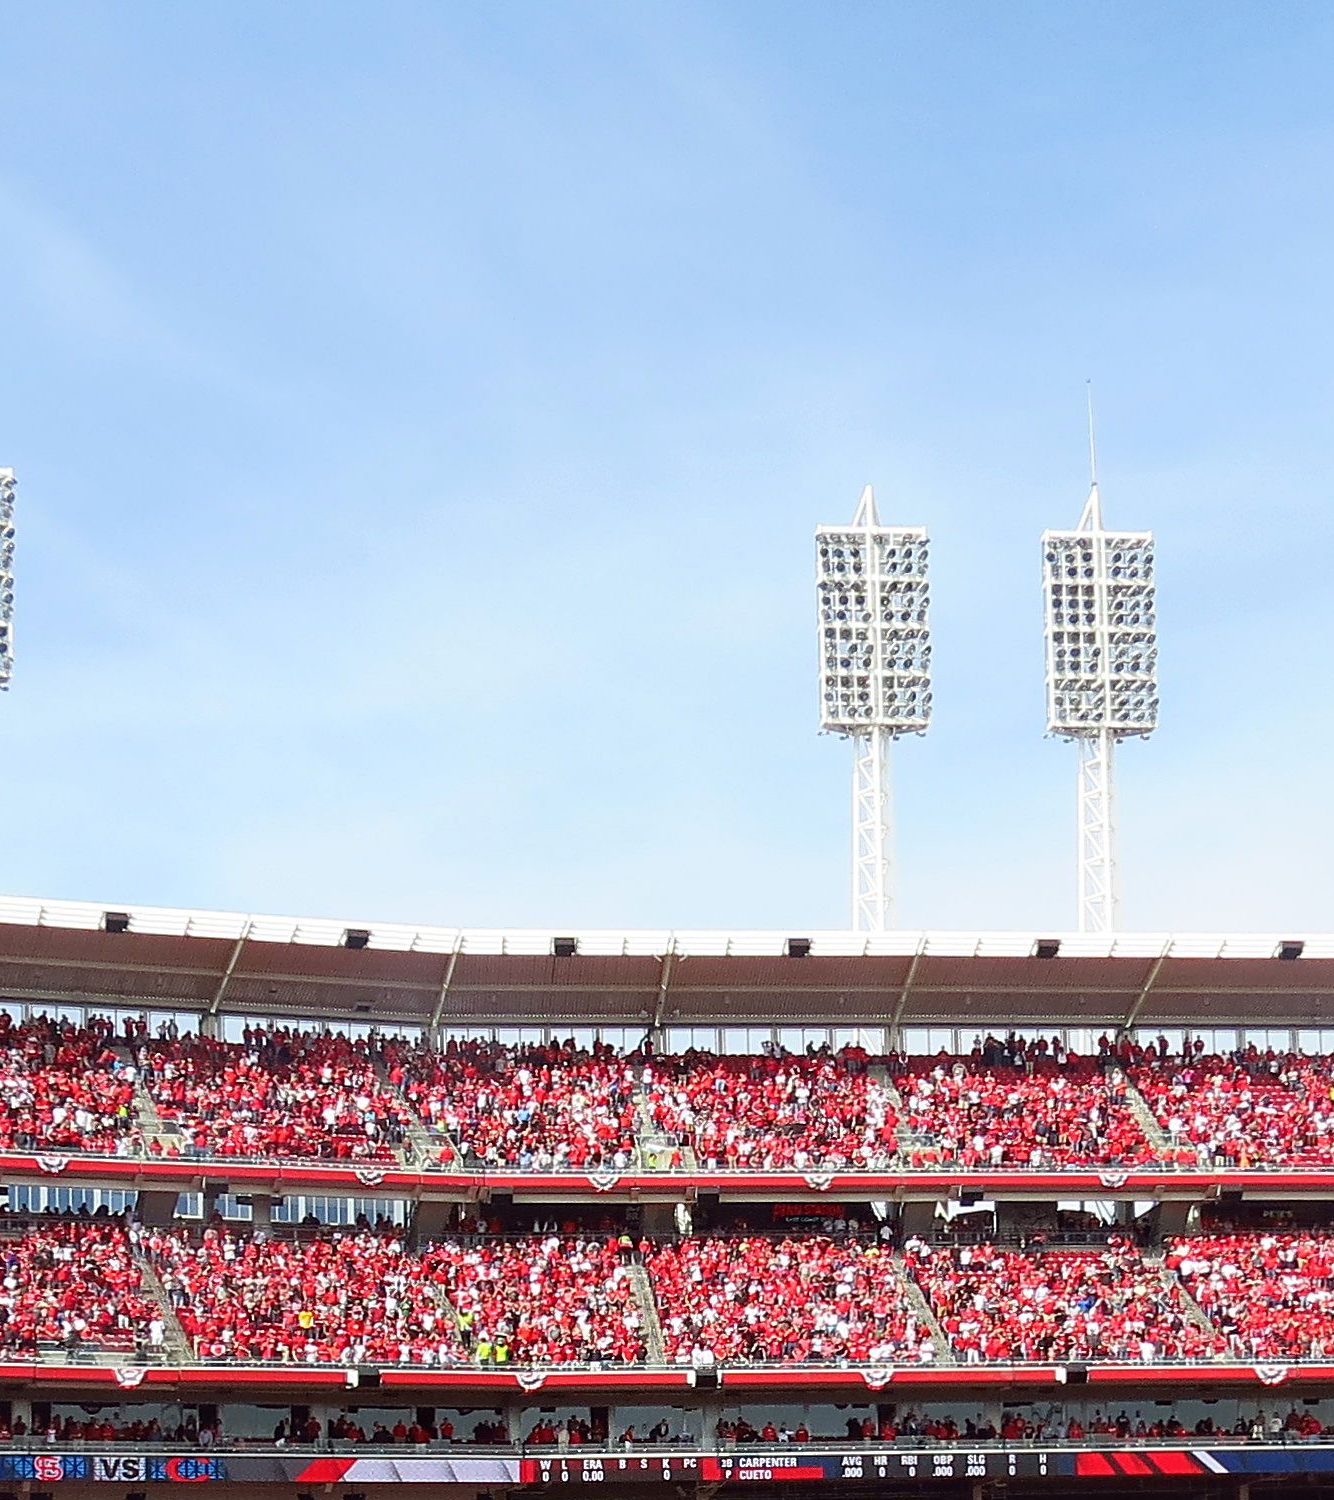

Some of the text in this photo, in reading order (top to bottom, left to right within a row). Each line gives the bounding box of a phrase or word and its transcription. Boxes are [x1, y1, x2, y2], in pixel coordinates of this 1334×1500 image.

[540, 1458, 697, 1470] W L ERA B S K PC
[739, 1457, 797, 1467] CARPENTER
[842, 1456, 863, 1466] AVG
[874, 1456, 887, 1466] HR
[901, 1455, 917, 1465] RBI
[933, 1455, 953, 1465] OBP
[967, 1454, 985, 1464] SLG
[1009, 1454, 1016, 1464] R
[1039, 1454, 1047, 1463] H
[100, 1457, 142, 1480] VS
[726, 1465, 1047, 1479] P CUETO .000 0 0 .000 .000 0 0
[542, 1470, 670, 1482] 0 0 0.00 0
